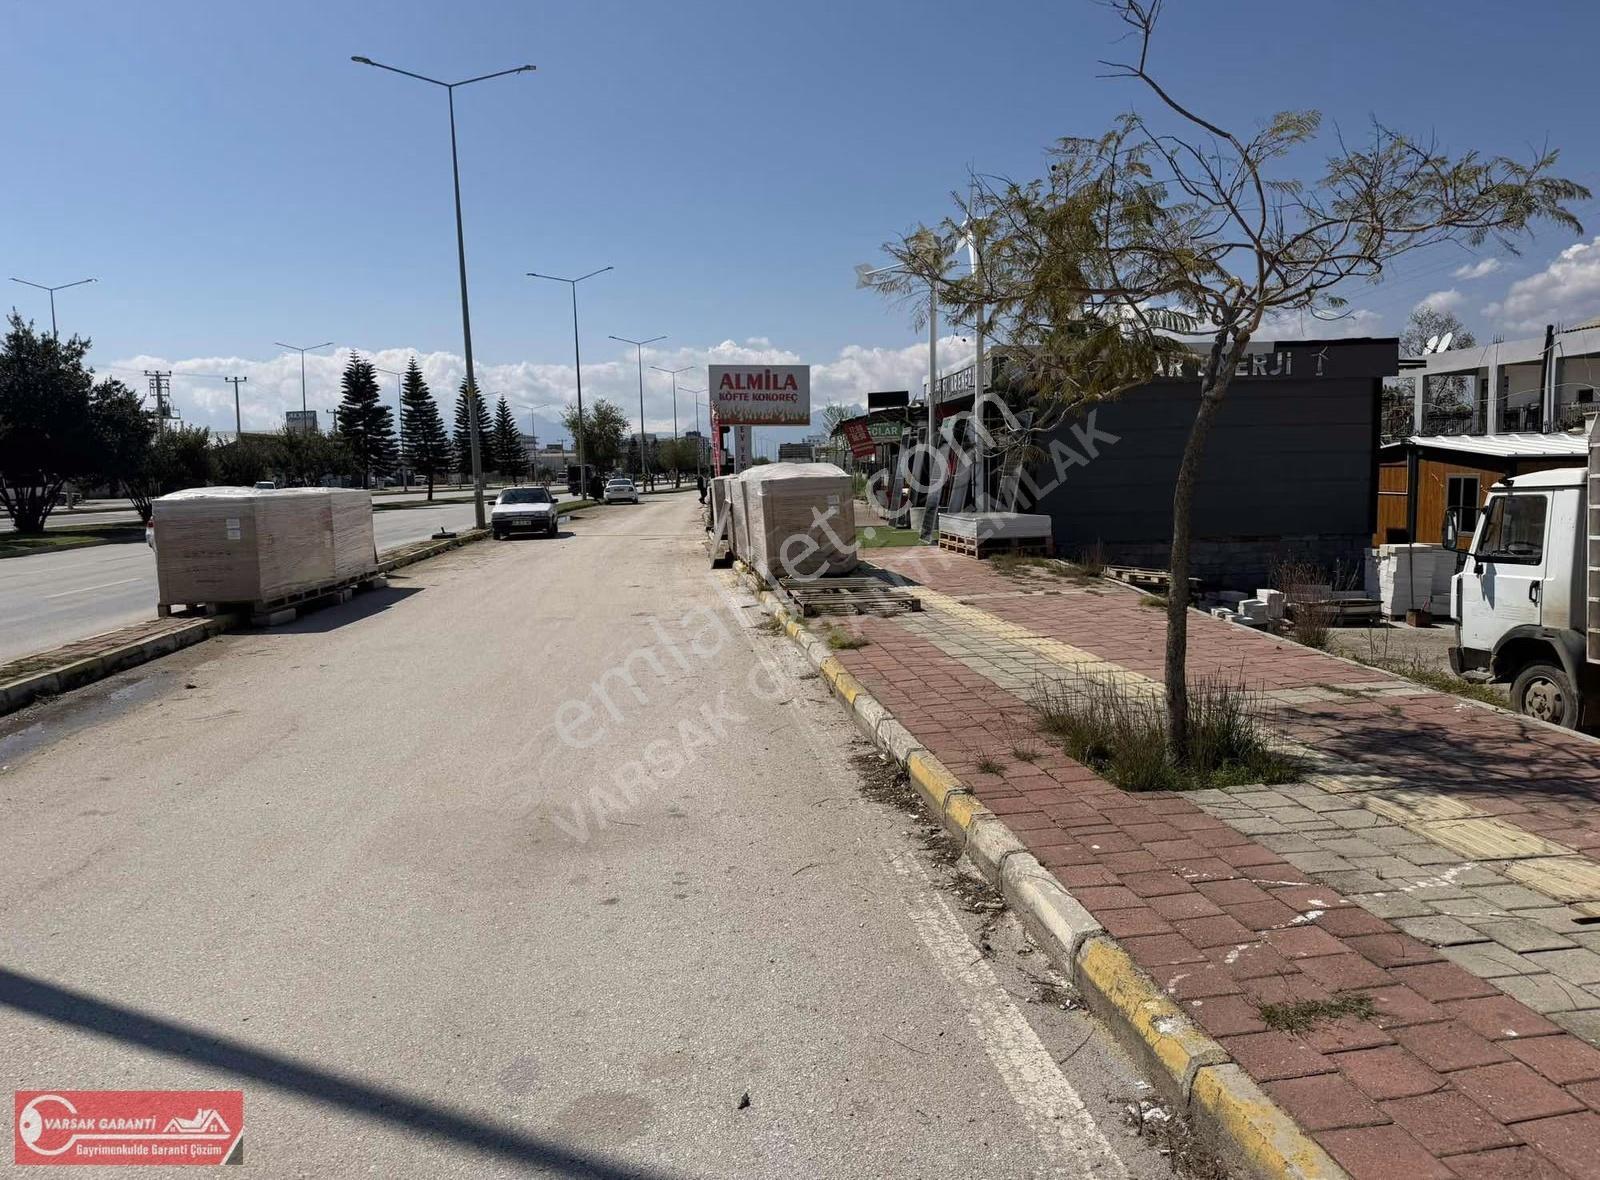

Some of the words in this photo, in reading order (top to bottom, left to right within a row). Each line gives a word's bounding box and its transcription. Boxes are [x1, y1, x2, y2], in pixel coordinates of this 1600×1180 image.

[720, 369, 798, 390] ALMİLA
[719, 391, 750, 401] KÖFTE
[752, 392, 798, 403] KOKOREÇ
